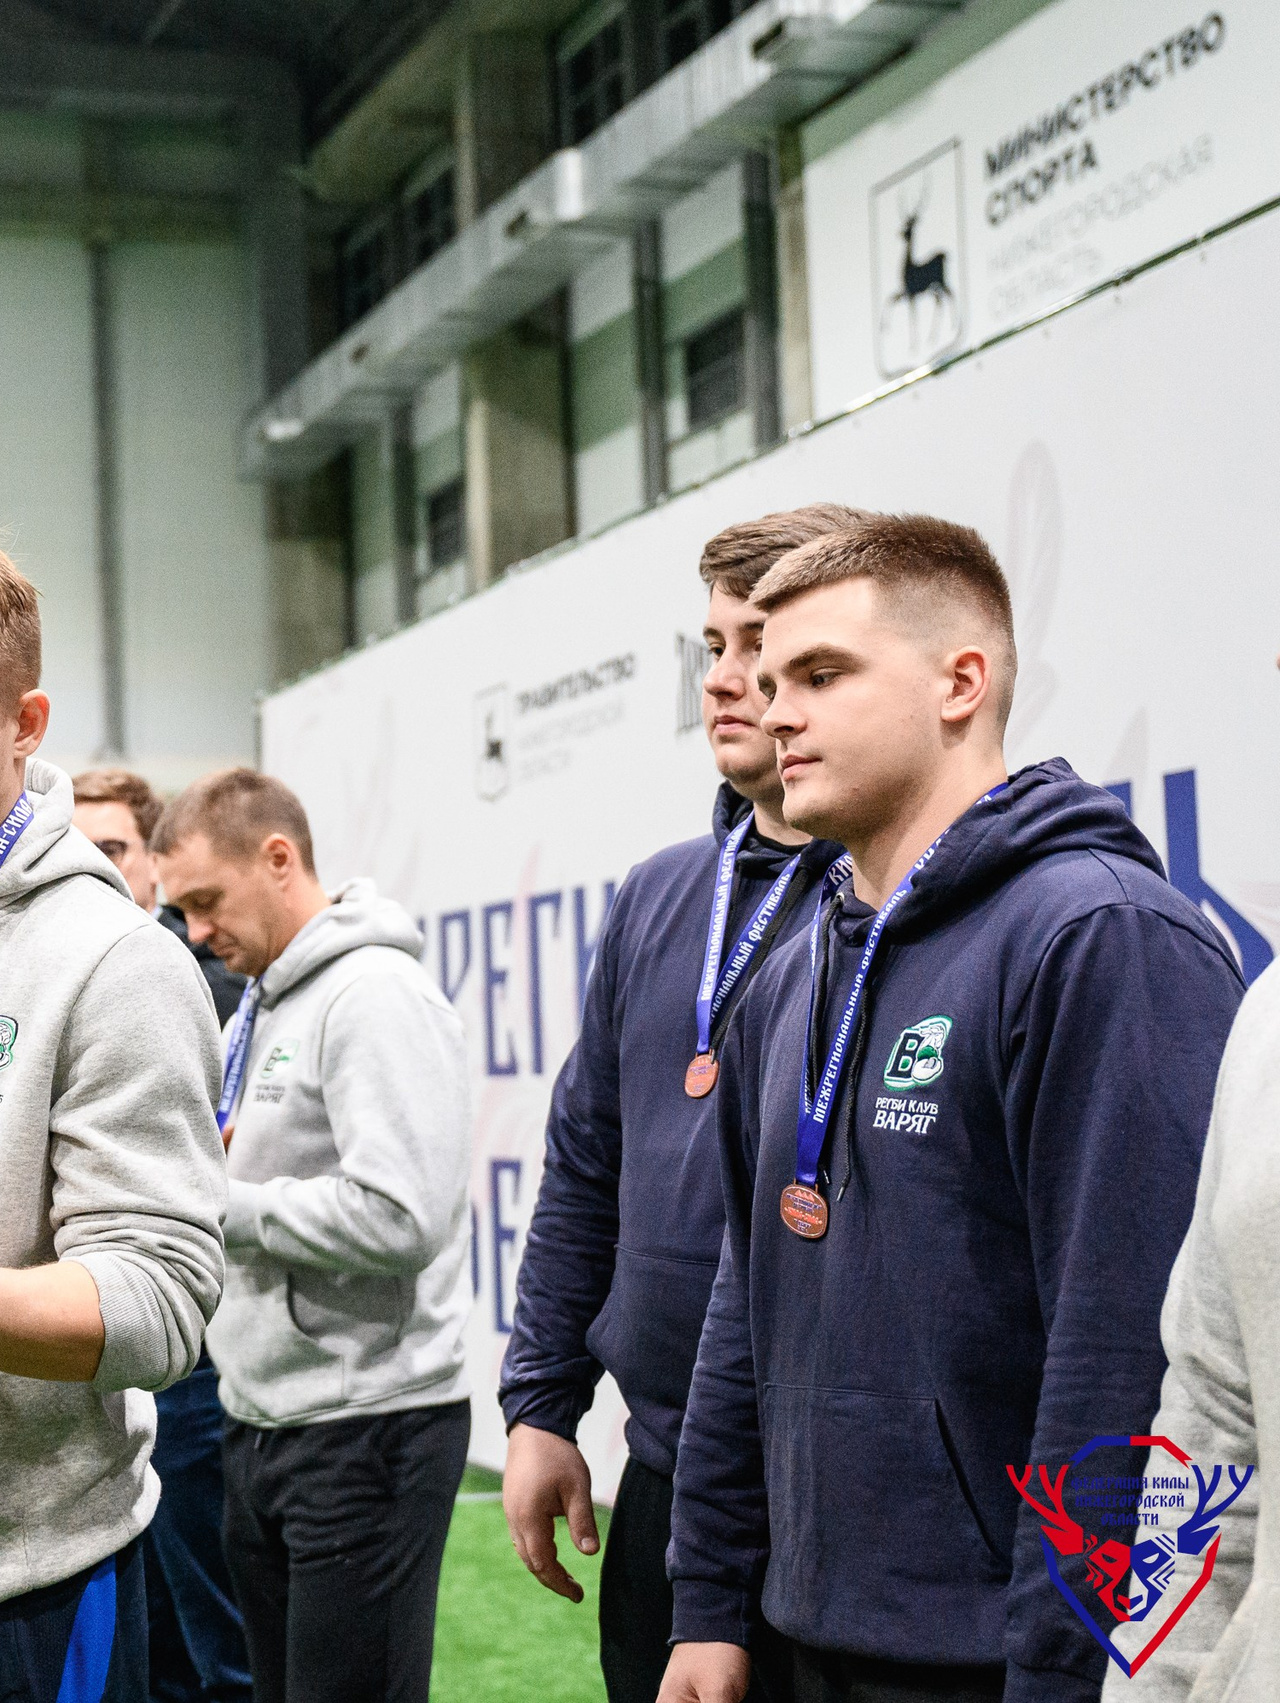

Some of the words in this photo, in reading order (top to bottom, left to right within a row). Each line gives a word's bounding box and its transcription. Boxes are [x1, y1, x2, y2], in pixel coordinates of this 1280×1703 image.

[984, 11, 1226, 178] МИНИСТЕРСТВО
[985, 138, 1098, 226] СПОРТА
[711, 941, 754, 1015] ИОНАЛЬНЫЙ
[748, 872, 790, 941] ФЕСТИВАЛЬ
[813, 972, 864, 1123] МЕЖРЕГИОНАЛЬНЫЙ
[861, 888, 908, 969] ФЕСТИВАЛЬ
[872, 1109, 937, 1134] ВАРЯГ
[875, 1097, 906, 1112] РЕГБИ
[908, 1100, 939, 1115] КЛУБ
